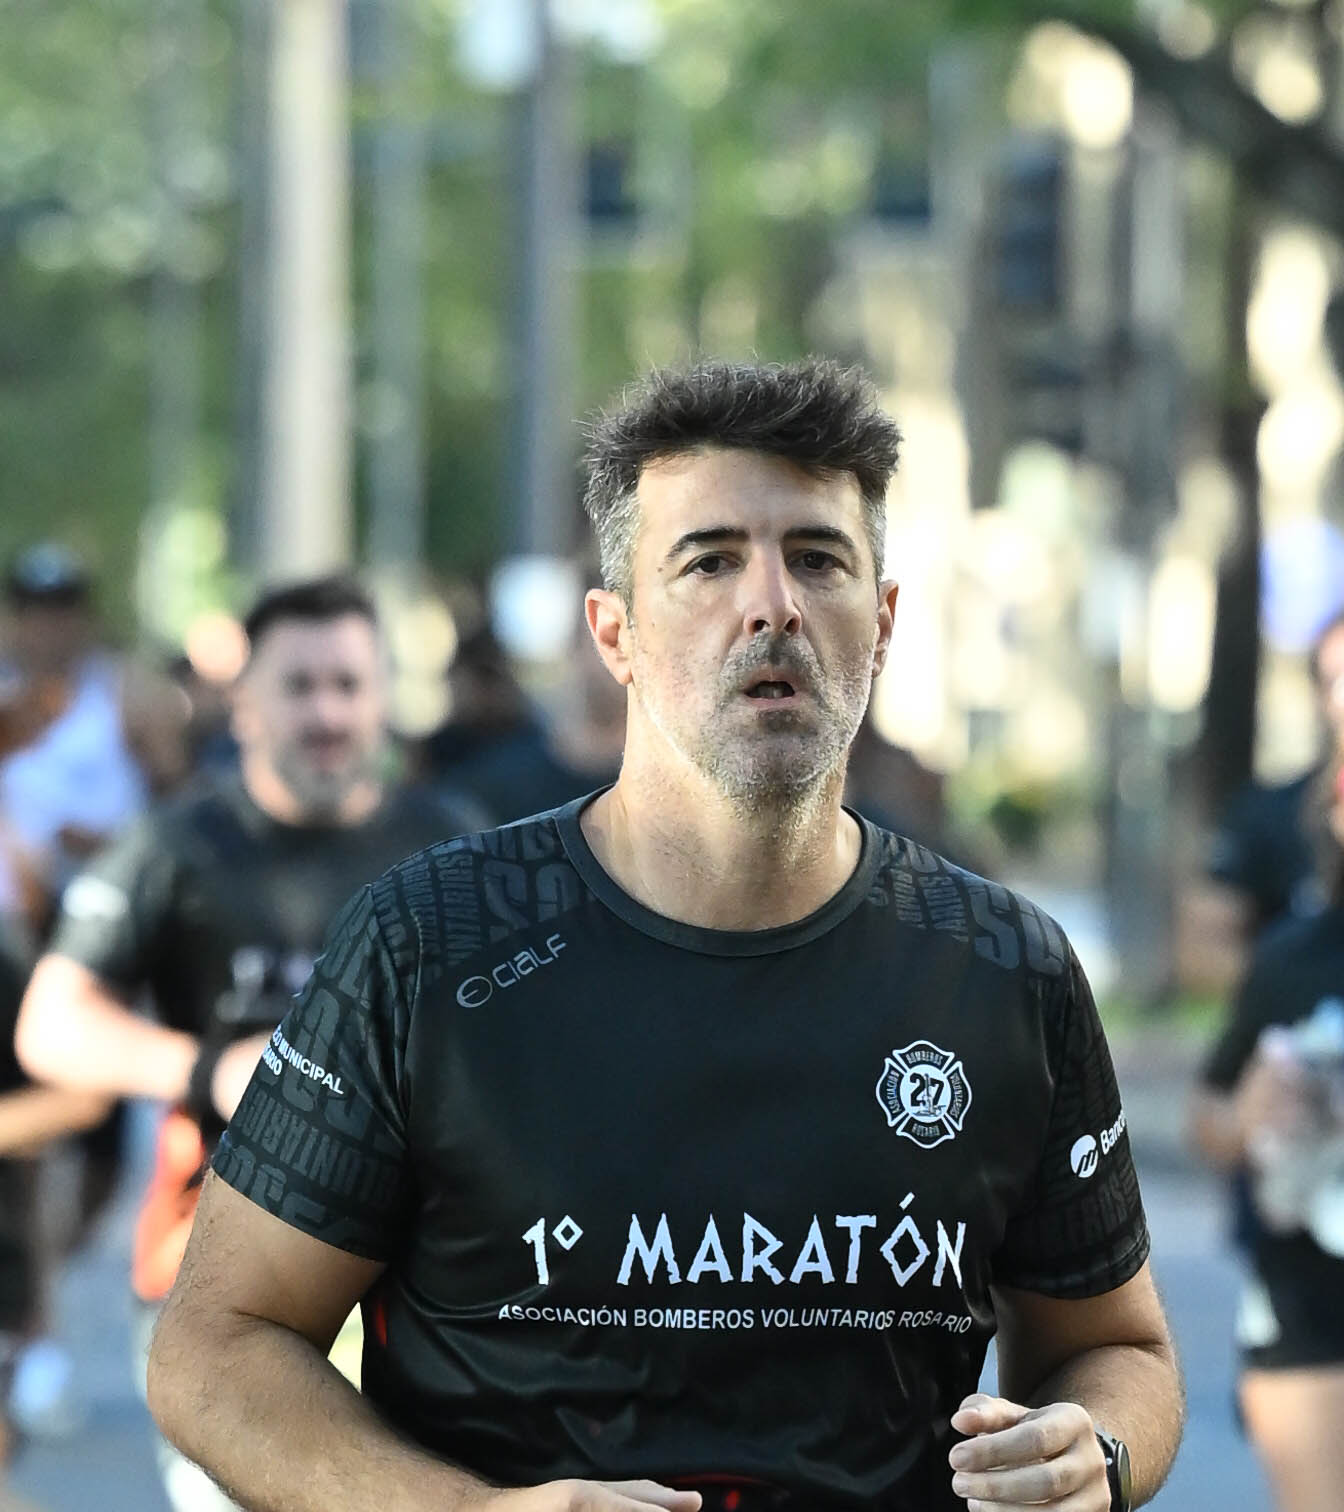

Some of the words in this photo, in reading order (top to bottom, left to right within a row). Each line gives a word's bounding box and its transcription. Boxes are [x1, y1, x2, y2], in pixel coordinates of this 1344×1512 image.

[277, 1037, 345, 1095] MUNICIPAL
[909, 1072, 945, 1108] 27
[616, 1191, 968, 1289] MARATÓN
[498, 1304, 627, 1327] ASOCIACIÓN
[633, 1308, 755, 1329] BOMBEROS
[761, 1307, 895, 1330] VOLUNTARIOS
[897, 1310, 973, 1334] ROSARIO
